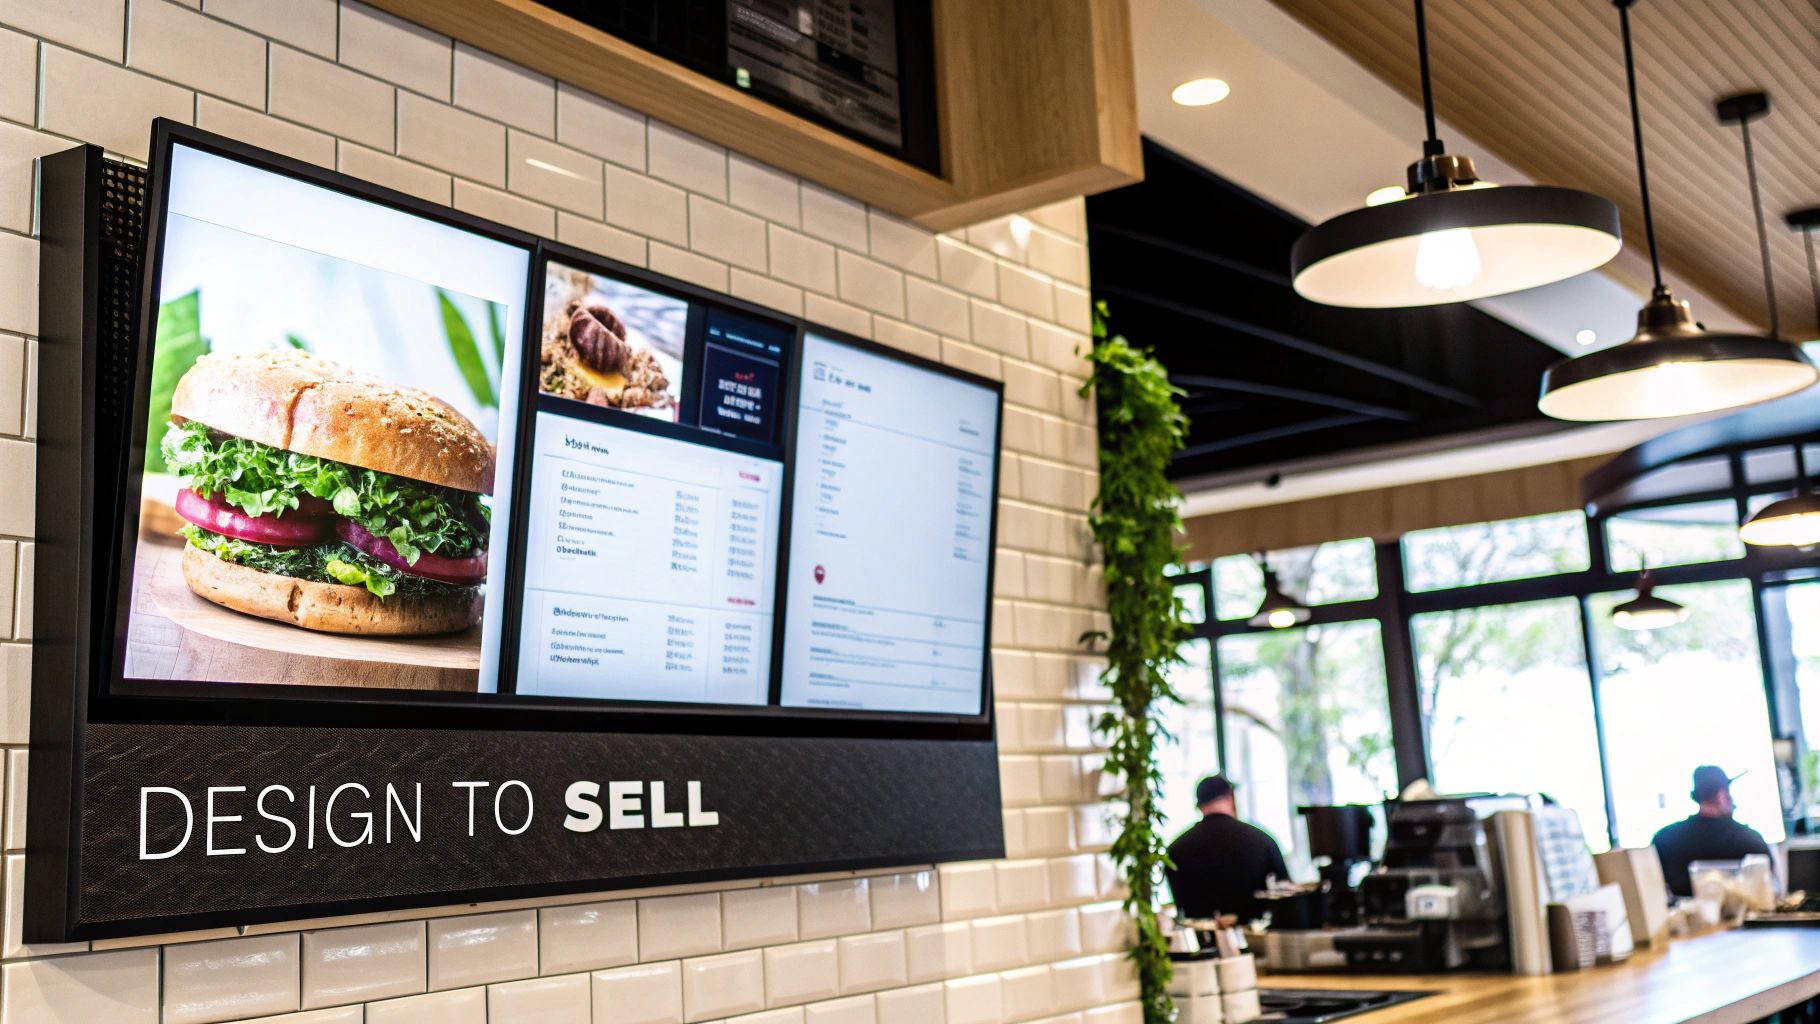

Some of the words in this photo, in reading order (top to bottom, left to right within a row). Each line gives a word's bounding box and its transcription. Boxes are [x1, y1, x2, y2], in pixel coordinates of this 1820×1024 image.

[139, 782, 422, 860] DESIGN
[452, 780, 534, 837] TO
[563, 780, 720, 833] SELL
